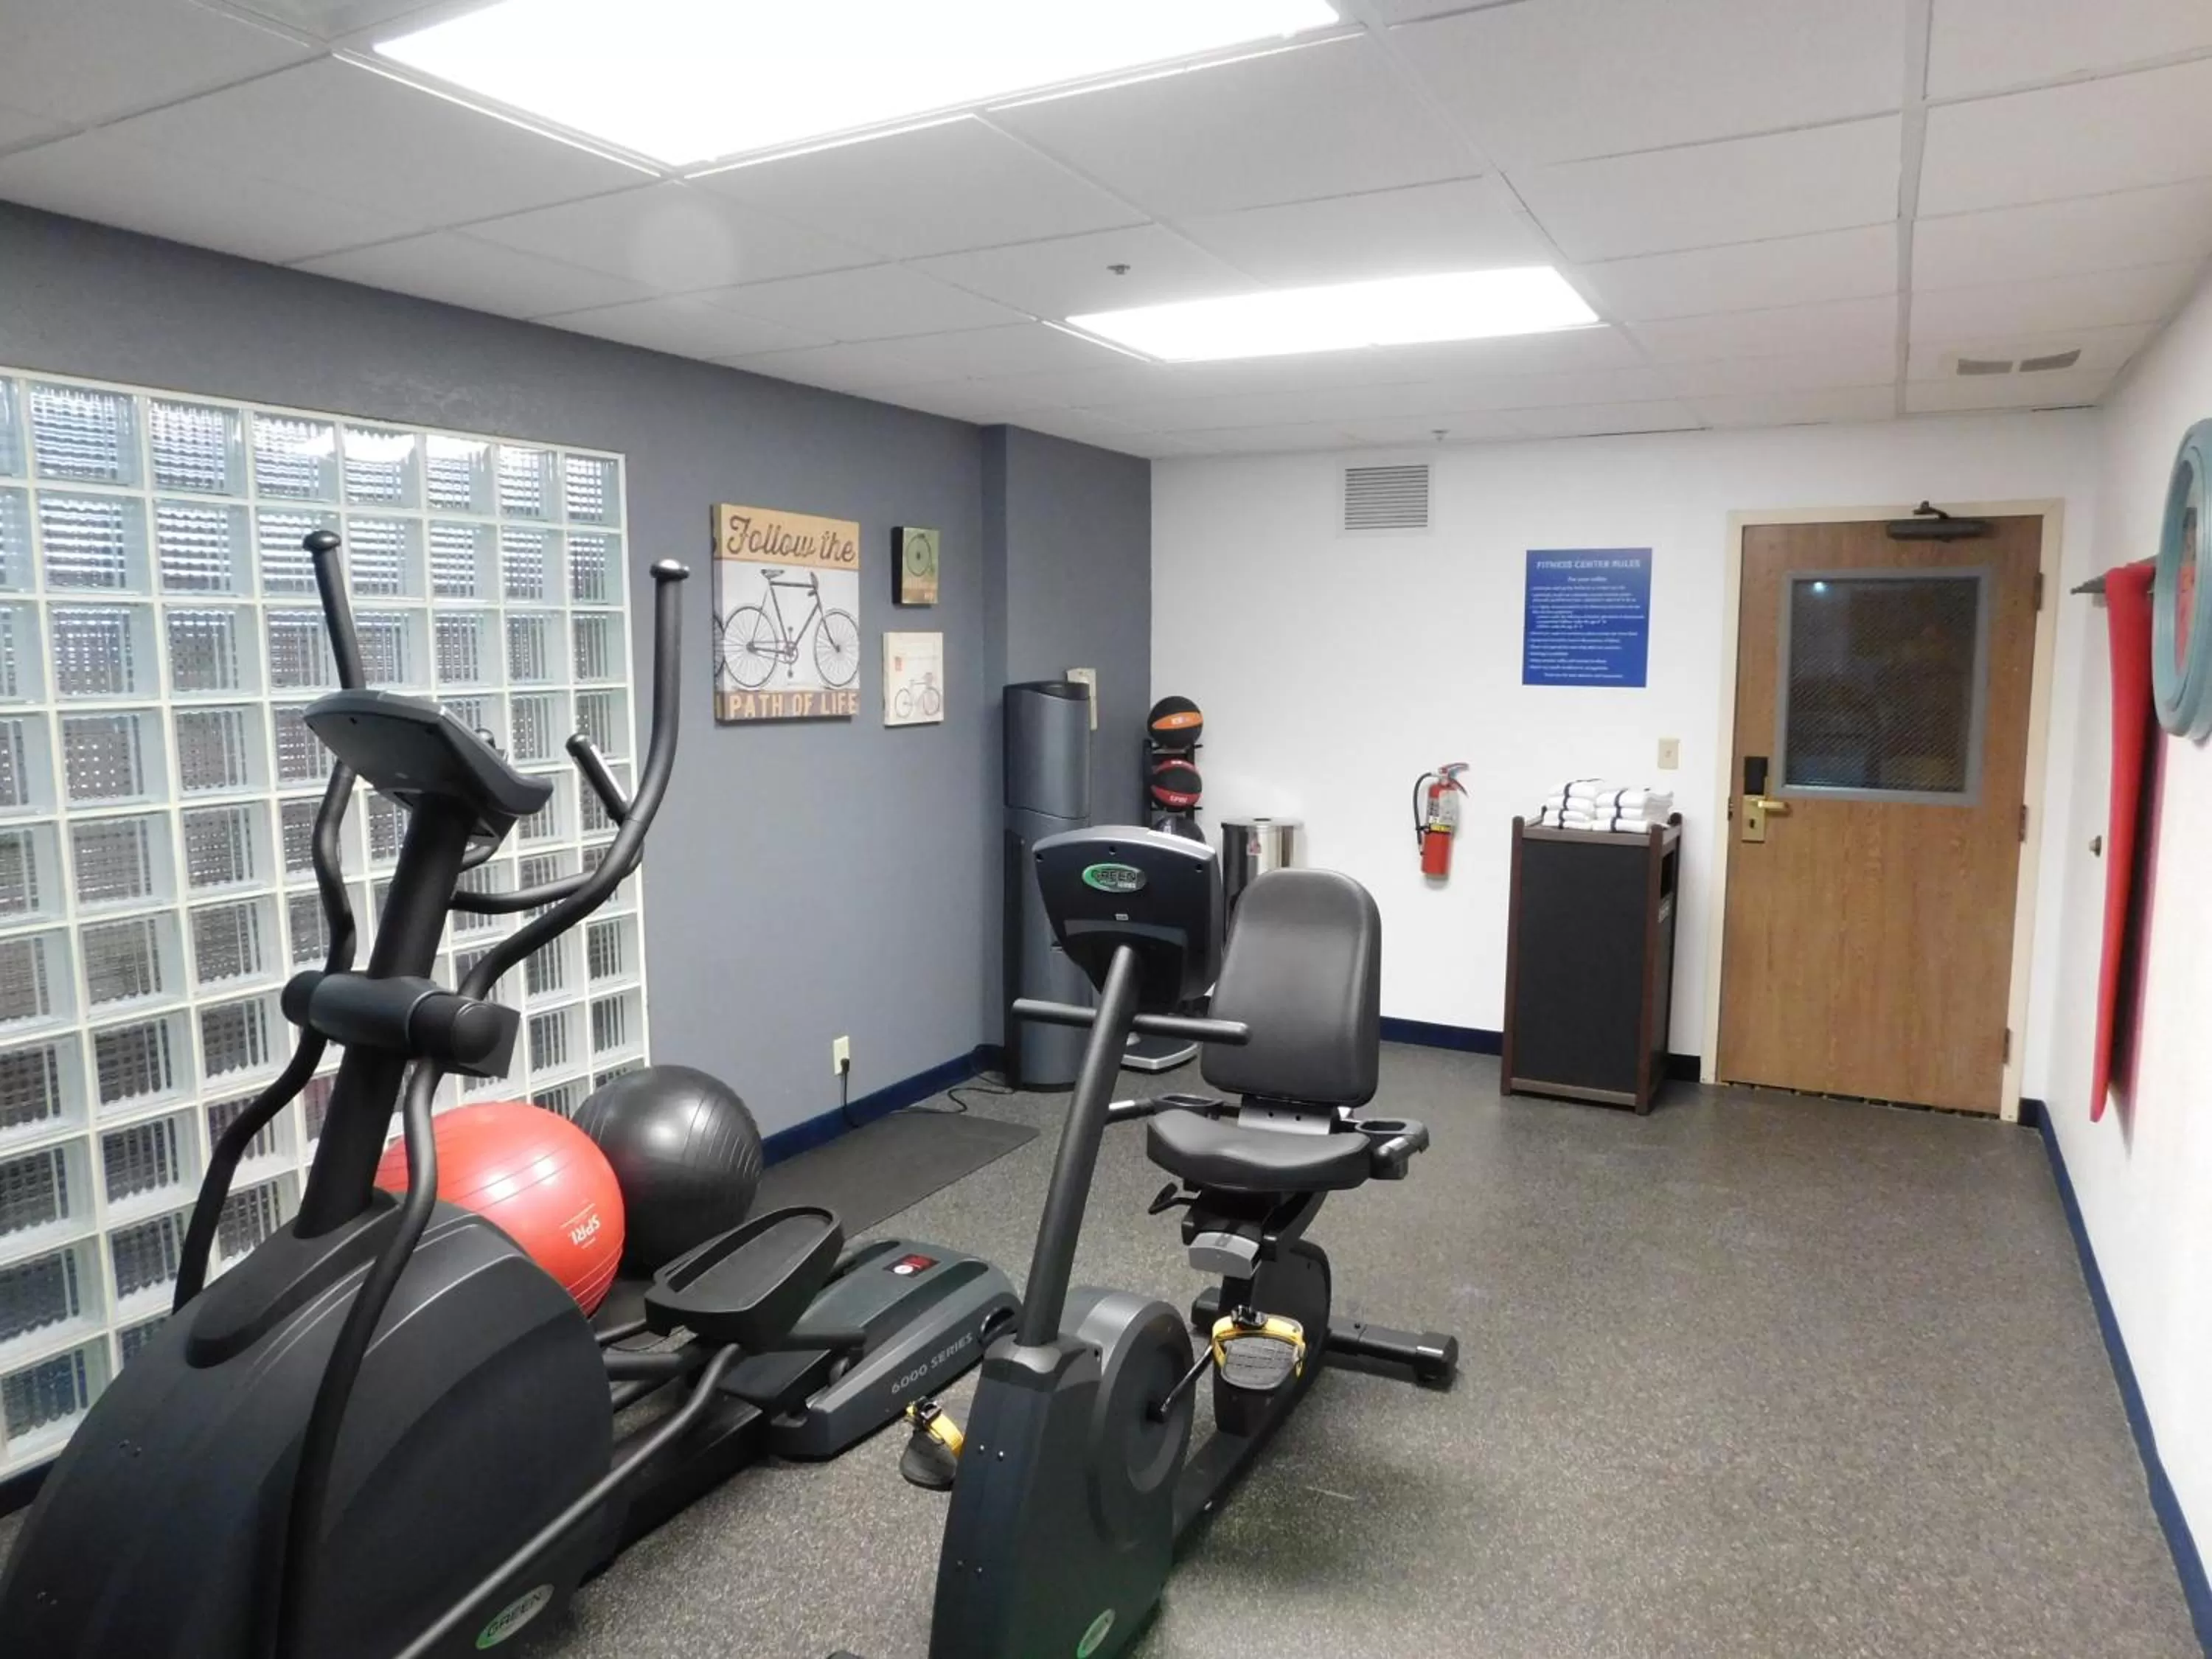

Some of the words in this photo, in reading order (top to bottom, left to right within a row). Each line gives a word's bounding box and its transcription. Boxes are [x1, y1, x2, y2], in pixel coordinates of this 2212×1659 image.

[727, 515, 815, 558] Follow
[819, 530, 856, 563] the
[1536, 560, 1572, 569] FITNESS
[1574, 560, 1610, 569] CENTER
[1612, 559, 1641, 568] RULES
[729, 694, 783, 717] PATH
[793, 693, 814, 715] OF
[820, 692, 858, 715] LIFE
[571, 1213, 601, 1245] SPRI
[891, 1364, 928, 1394] 6000
[931, 1332, 973, 1369] SERIES
